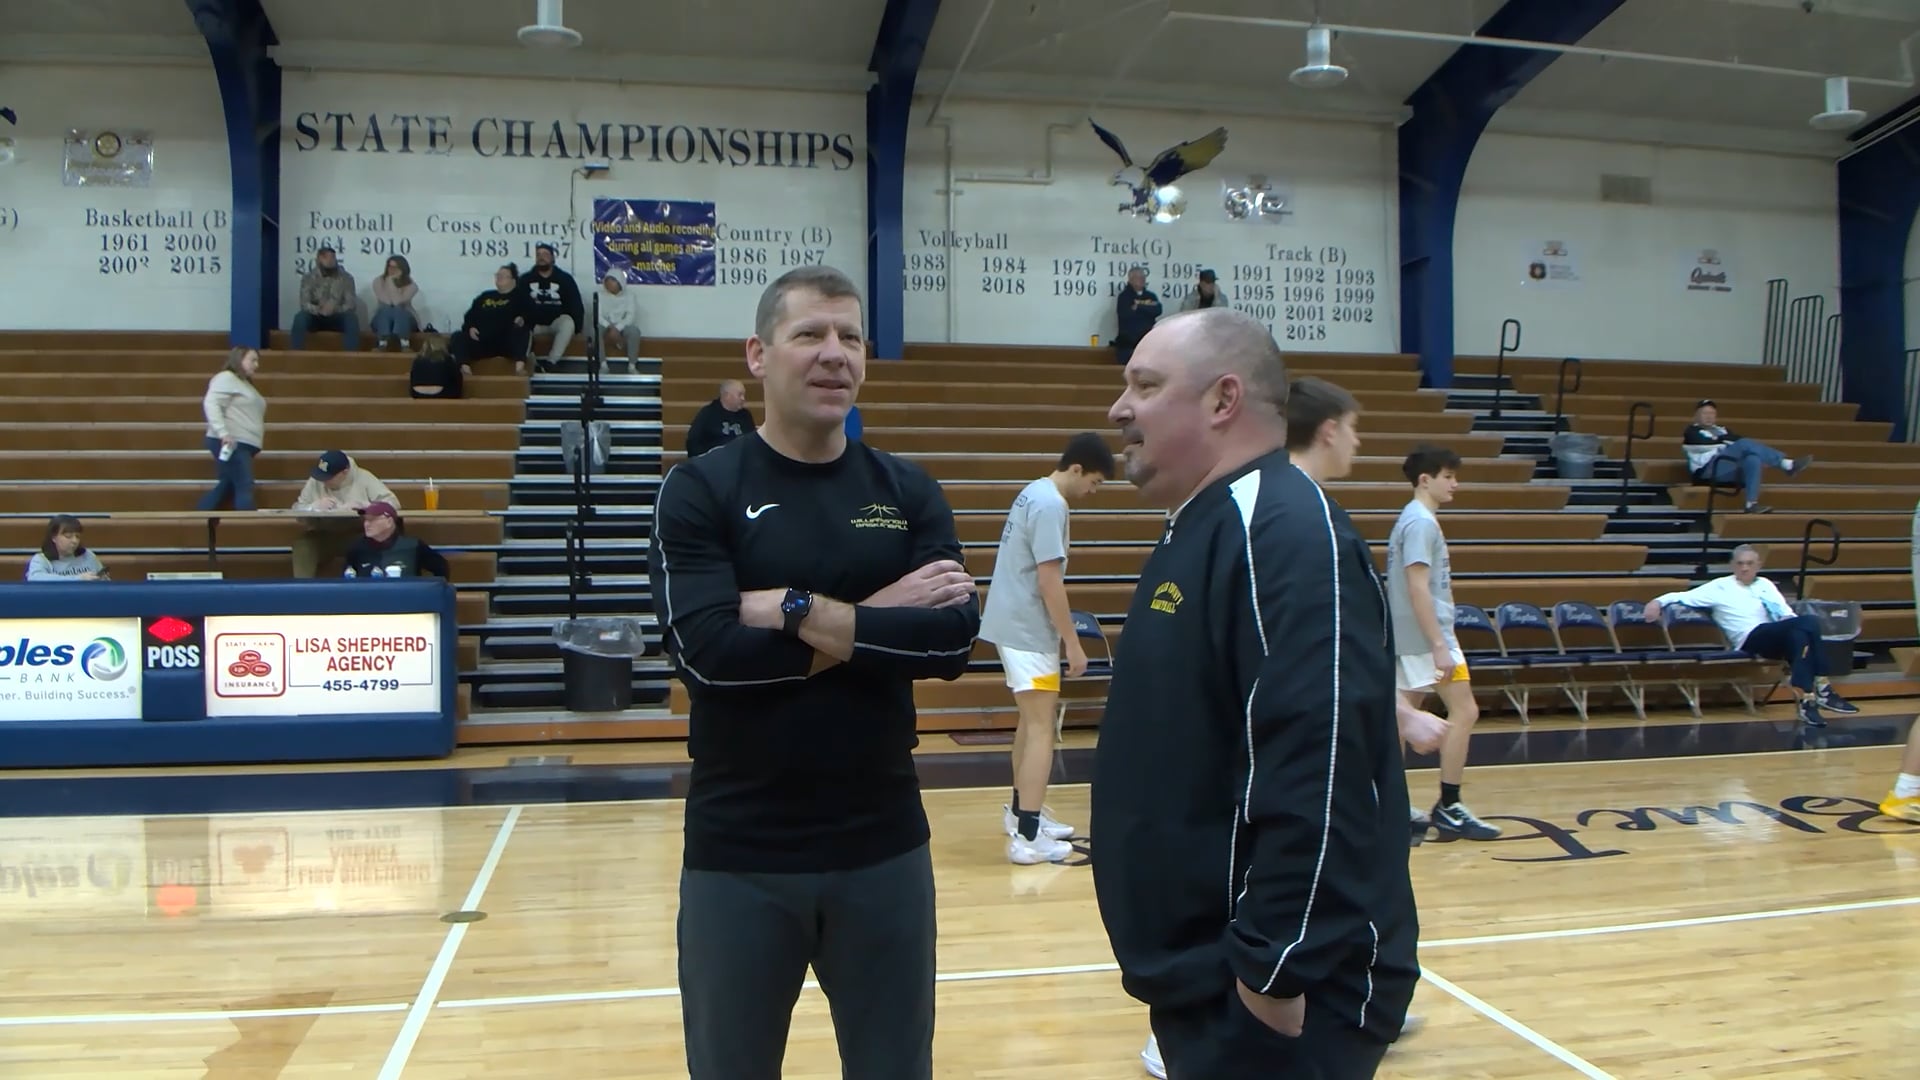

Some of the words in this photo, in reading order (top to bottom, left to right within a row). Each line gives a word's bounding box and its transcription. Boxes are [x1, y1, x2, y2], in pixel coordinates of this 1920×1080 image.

[295, 111, 454, 156] STATE
[471, 117, 855, 171] CHAMPIONSHIPS
[85, 208, 193, 228] Basketball
[203, 209, 228, 231] (B
[310, 211, 393, 231] Football
[427, 214, 481, 234] Cross
[490, 216, 570, 239] Country
[595, 221, 622, 233] Video
[623, 222, 641, 233] and
[642, 222, 670, 234] Audio
[101, 233, 149, 251] 1961
[165, 234, 217, 252] 2000
[716, 223, 793, 247] Country
[801, 227, 833, 246] (B)
[919, 229, 1008, 252] Volleyball
[295, 235, 345, 254] 1964
[360, 237, 411, 255] 2010
[459, 239, 509, 257] 1983
[524, 240, 571, 258] 187
[608, 241, 639, 255] during
[641, 241, 652, 253] all
[654, 243, 683, 256] games
[1266, 243, 1312, 262] Track
[1319, 246, 1347, 266] (B)
[170, 256, 222, 275] 2015
[635, 260, 676, 273] matches
[720, 248, 767, 265] 1986
[780, 249, 825, 266] 1987
[903, 254, 945, 271] 1983
[982, 256, 1027, 274] 1984
[720, 267, 767, 285] 1996
[1053, 259, 1096, 276] 1979
[1233, 264, 1273, 282] 1991
[1284, 266, 1325, 284] 1992
[1335, 268, 1375, 286] 1993
[903, 274, 946, 292] 1999
[982, 276, 1026, 295] 2018
[1053, 279, 1097, 297] 1996
[1233, 285, 1275, 301] 1995
[1284, 286, 1325, 303] 1996
[1335, 287, 1375, 304] 1999
[1285, 304, 1325, 322] 2001
[1332, 306, 1373, 323] 2002
[1286, 324, 1326, 341] 2018
[295, 638, 332, 654] LISA
[337, 636, 427, 653] SHEPHERD
[147, 644, 201, 668] POSS
[326, 655, 396, 672] AGENCY
[20, 673, 76, 684] BANK
[322, 678, 400, 692] 455-4799
[25, 689, 73, 702] Building
